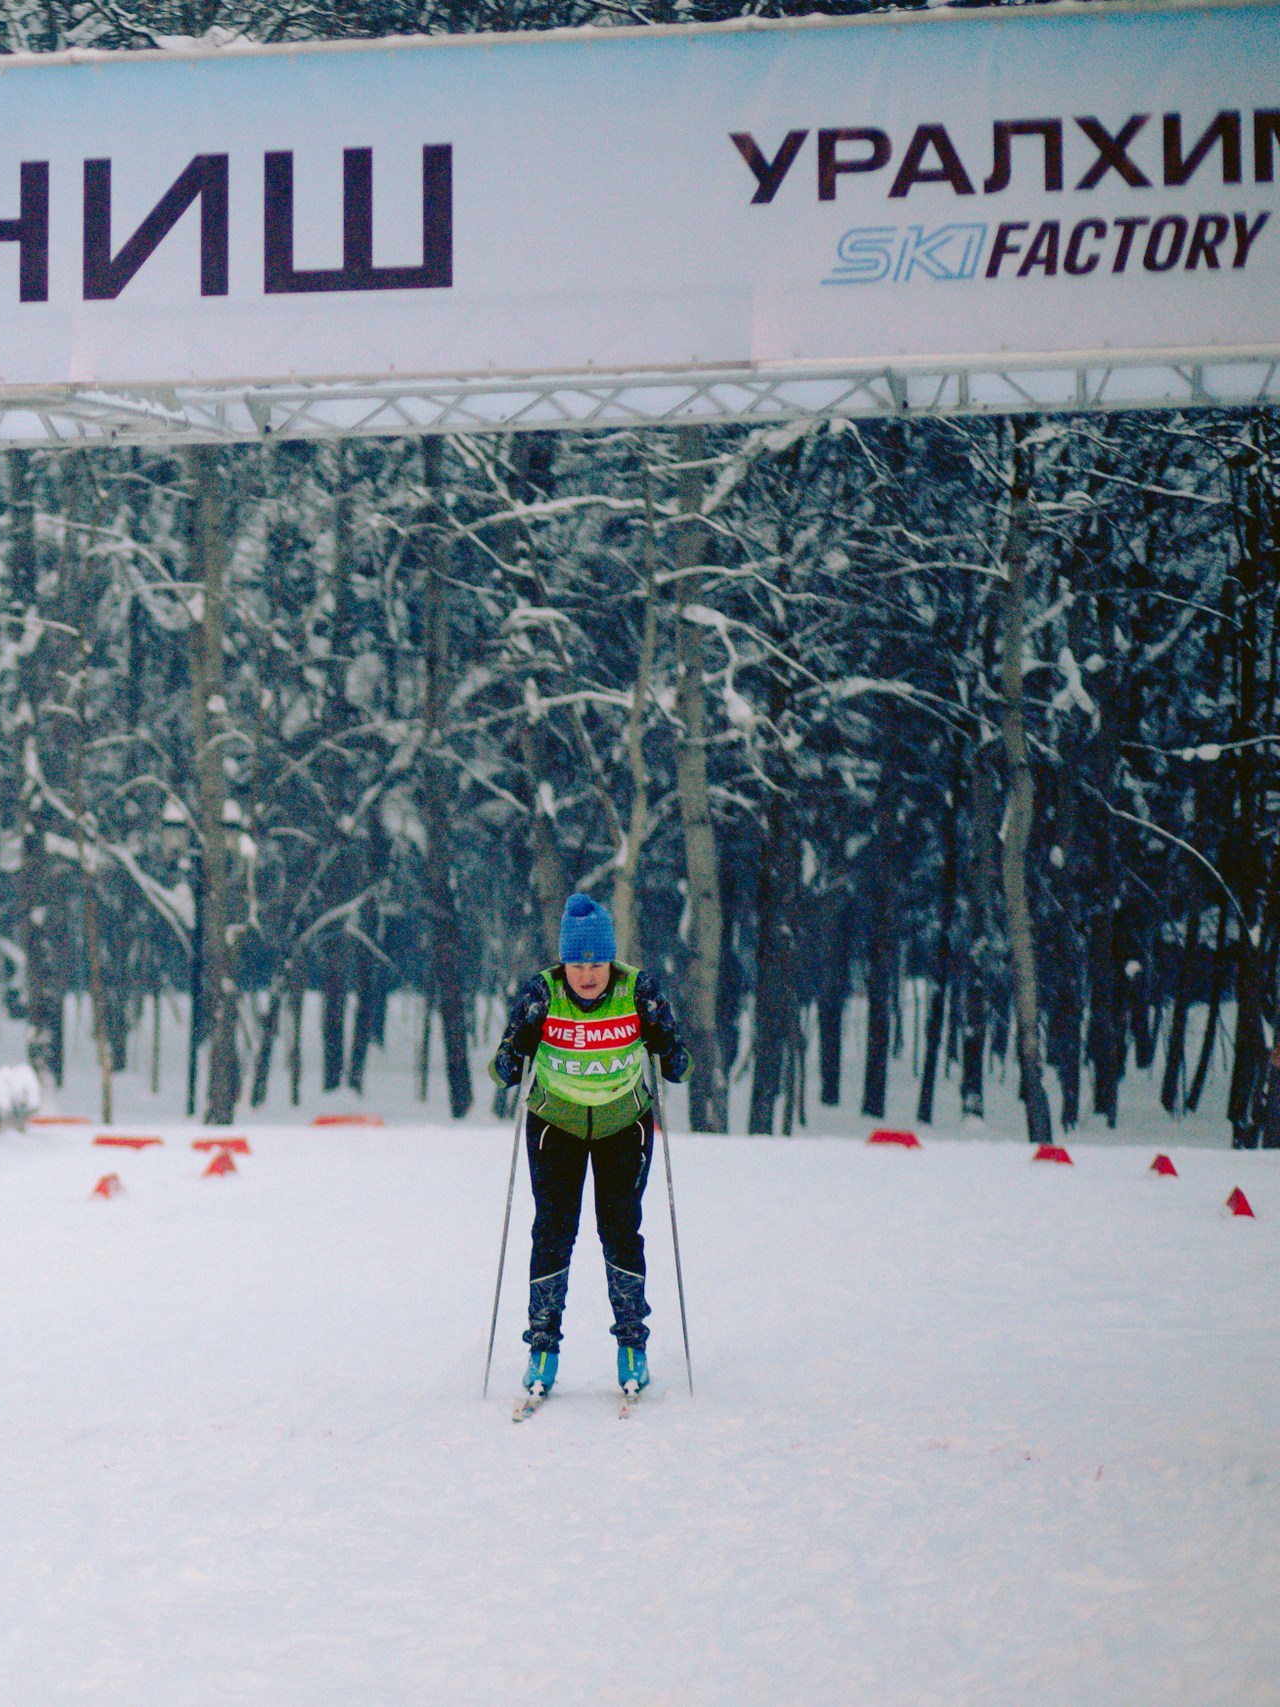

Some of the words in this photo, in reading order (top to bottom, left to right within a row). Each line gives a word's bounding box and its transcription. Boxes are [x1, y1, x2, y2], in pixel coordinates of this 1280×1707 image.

[728, 107, 1280, 204] УРАЛХИ
[548, 1023, 637, 1048] VIESSMANN
[548, 1053, 635, 1076] TEAM
